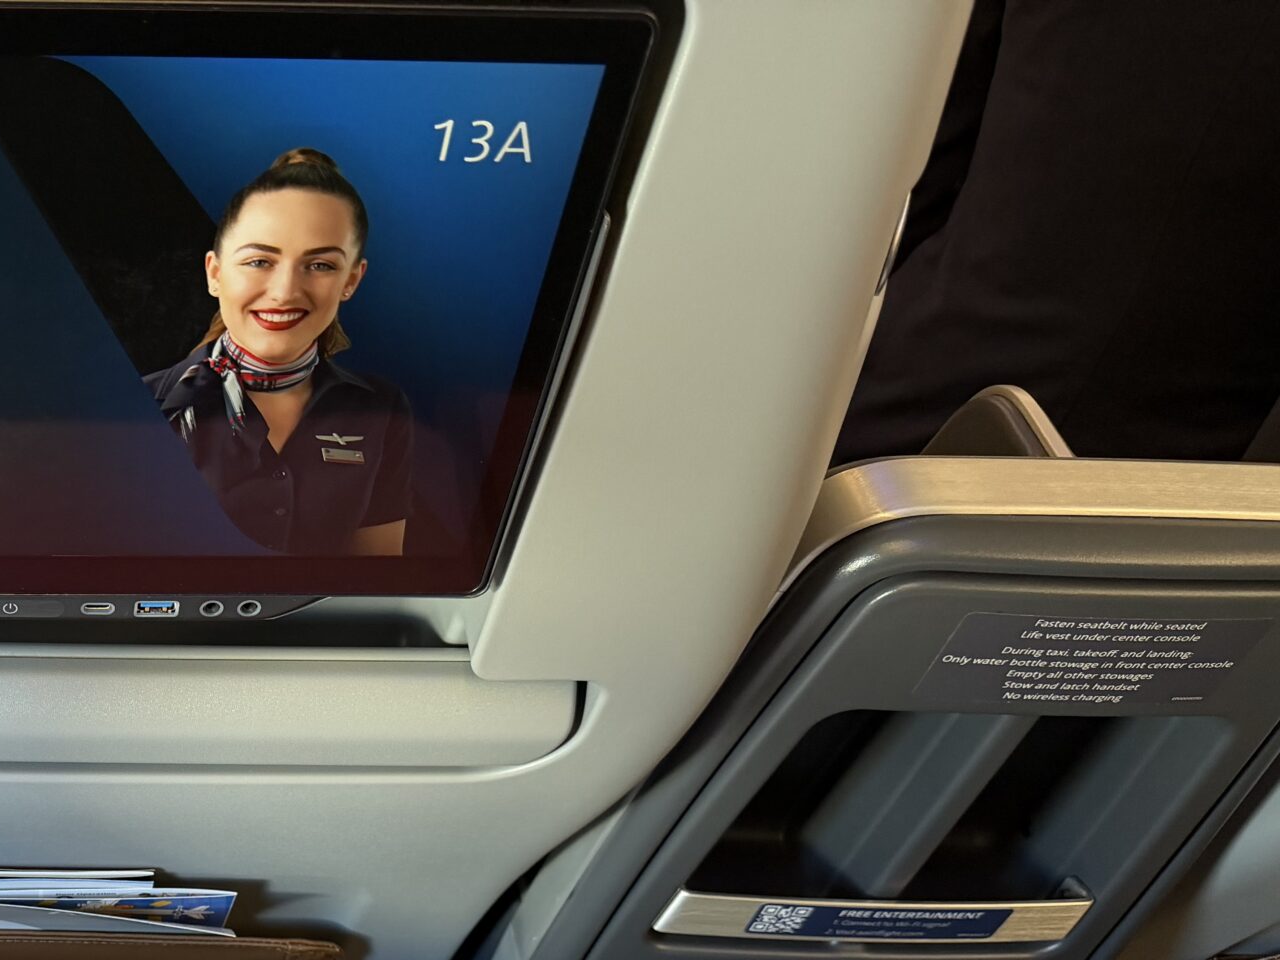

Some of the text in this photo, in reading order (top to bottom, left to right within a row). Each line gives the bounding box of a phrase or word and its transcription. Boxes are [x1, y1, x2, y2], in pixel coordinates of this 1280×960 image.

[434, 119, 532, 163] 13A
[1035, 619, 1208, 631] Fasten seatbelt while seated
[1020, 630, 1201, 642] Life vest under center console
[1001, 646, 1044, 657] During
[1120, 650, 1145, 658] and
[942, 654, 1234, 670] Only water bottle stowage in front center console
[1006, 669, 1154, 681] Empty all other stowages
[1001, 680, 1141, 691] Stow and latch handset
[1002, 692, 1123, 703] No wireless charging
[838, 909, 985, 919] FREE ENTERTAINMENT
